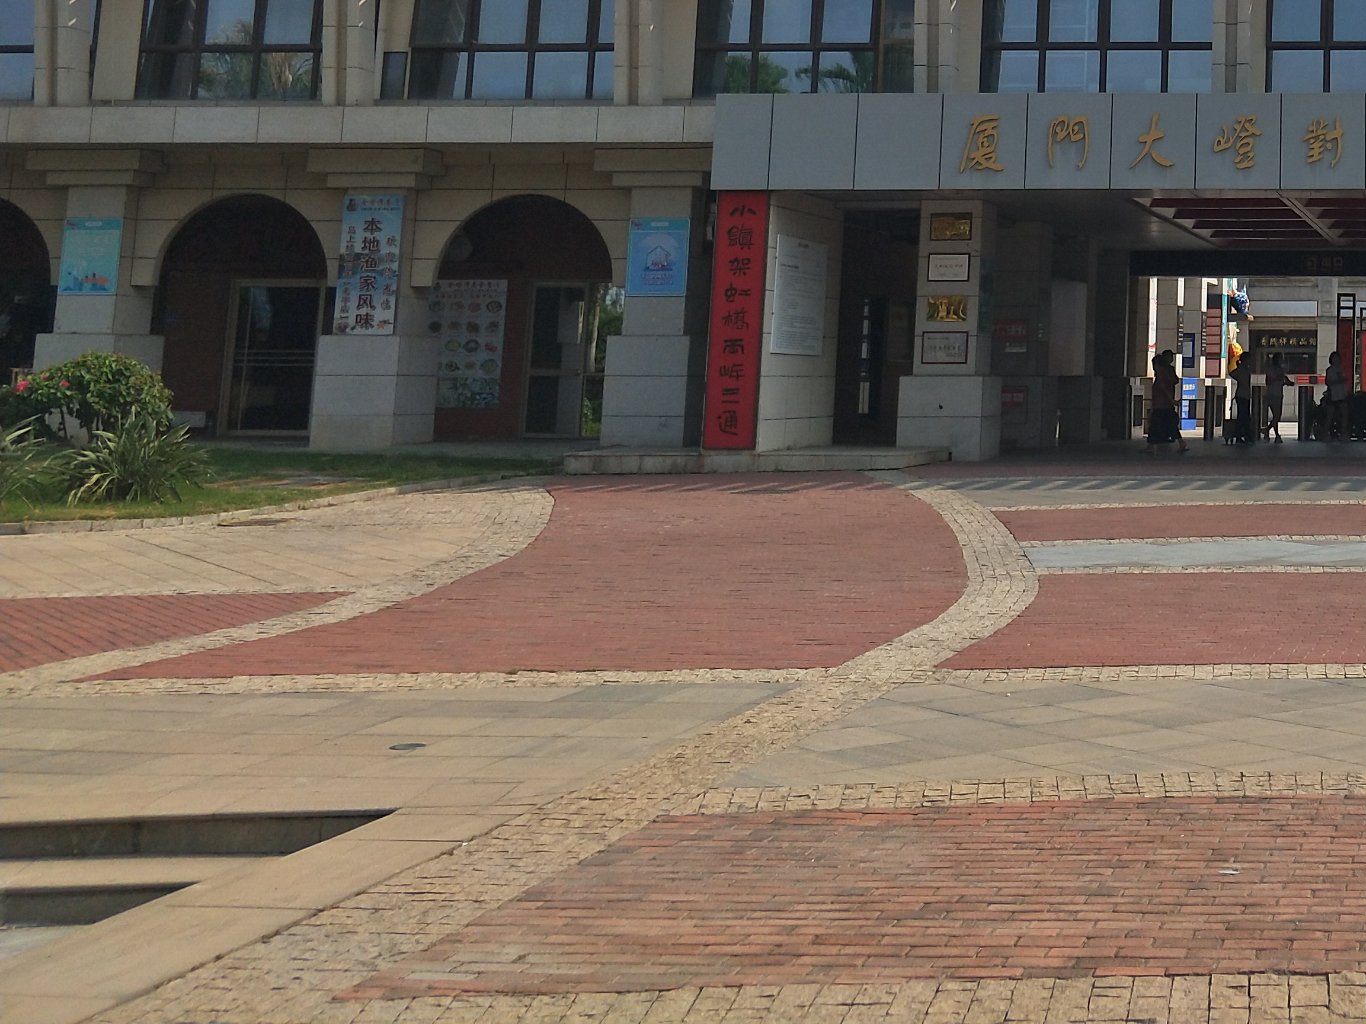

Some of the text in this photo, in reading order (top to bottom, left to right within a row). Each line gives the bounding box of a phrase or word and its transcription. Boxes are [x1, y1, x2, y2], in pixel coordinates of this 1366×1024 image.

[354, 217, 383, 330] 本地渔家风味
